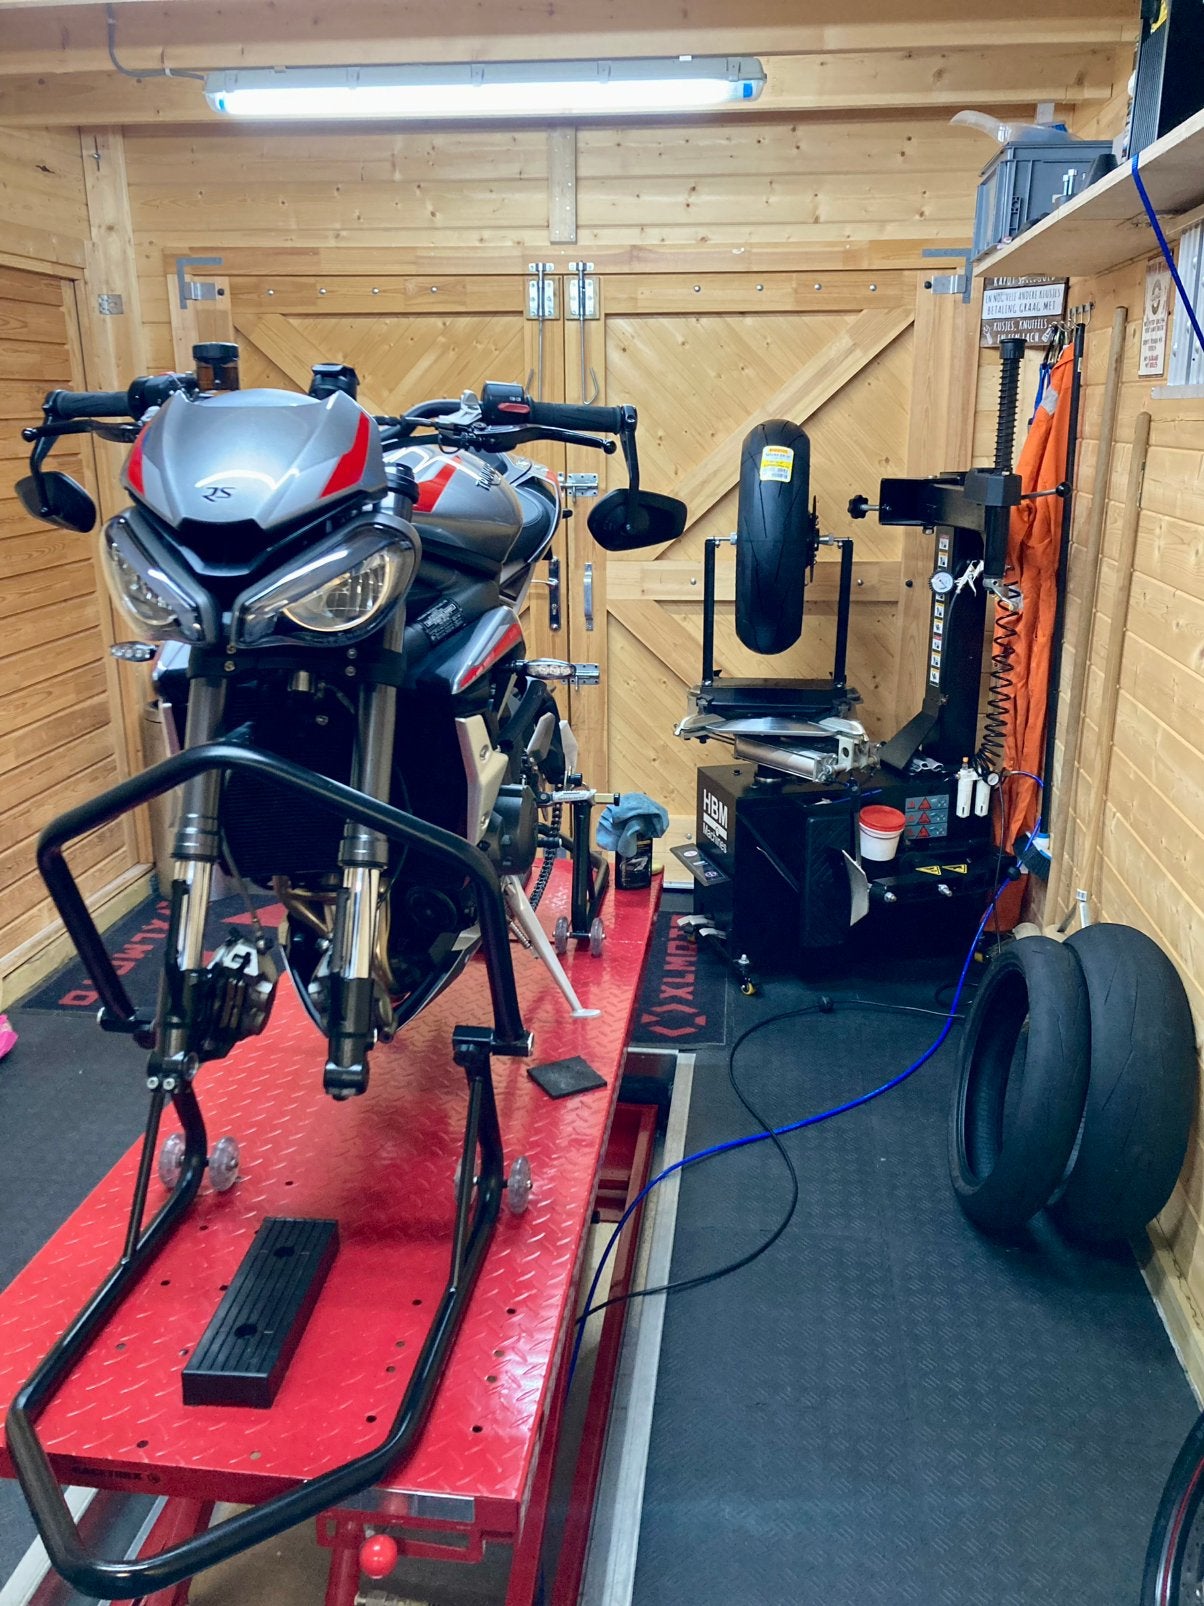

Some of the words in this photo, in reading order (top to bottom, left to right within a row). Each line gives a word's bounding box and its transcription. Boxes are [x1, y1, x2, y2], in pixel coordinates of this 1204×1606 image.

[1018, 289, 1038, 300] ANDERE
[987, 304, 1017, 315] BETALING
[1019, 302, 1041, 313] GRAAG
[1043, 300, 1056, 311] MET
[993, 320, 1017, 332] KUSJES,
[1018, 319, 1048, 330] KNUFFELS
[703, 788, 728, 829] HBM
